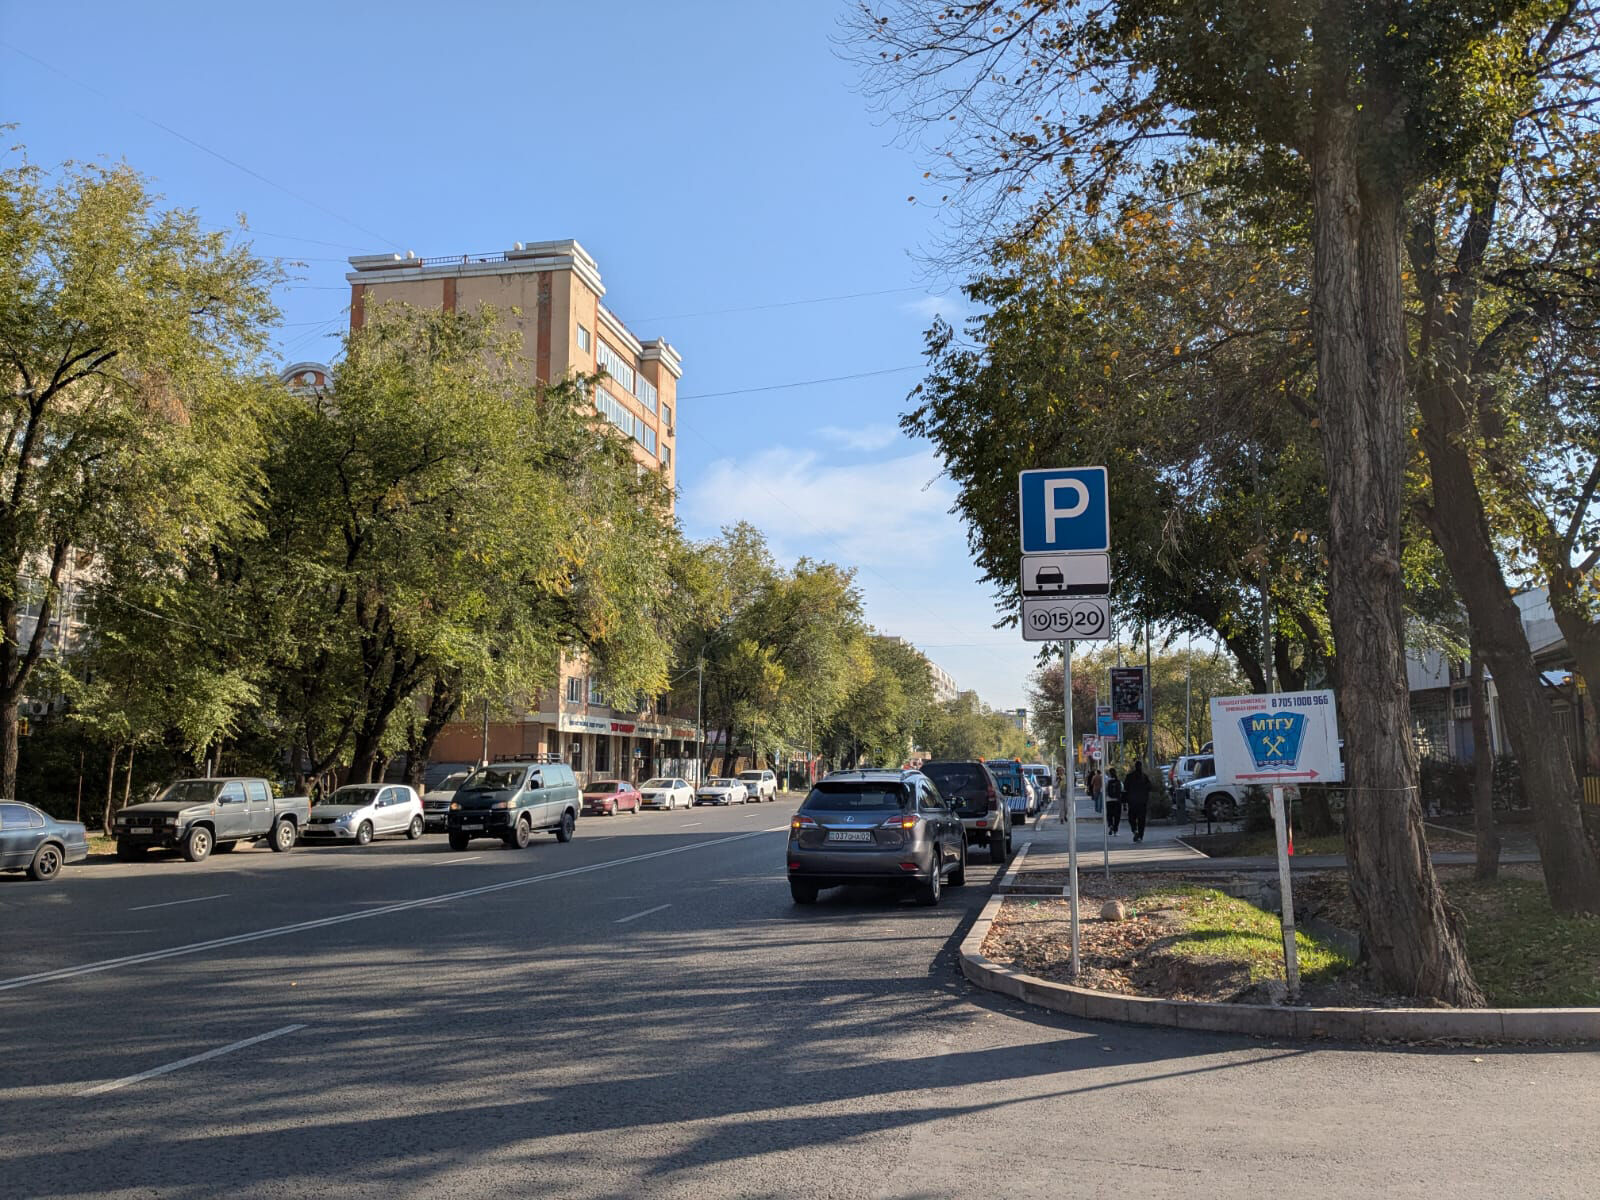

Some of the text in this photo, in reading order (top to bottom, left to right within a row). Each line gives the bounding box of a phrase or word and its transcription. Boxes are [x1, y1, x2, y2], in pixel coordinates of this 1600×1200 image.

[1044, 478, 1089, 544] P
[1032, 611, 1099, 626] 10 15 20
[1252, 718, 1294, 731] МТГУ
